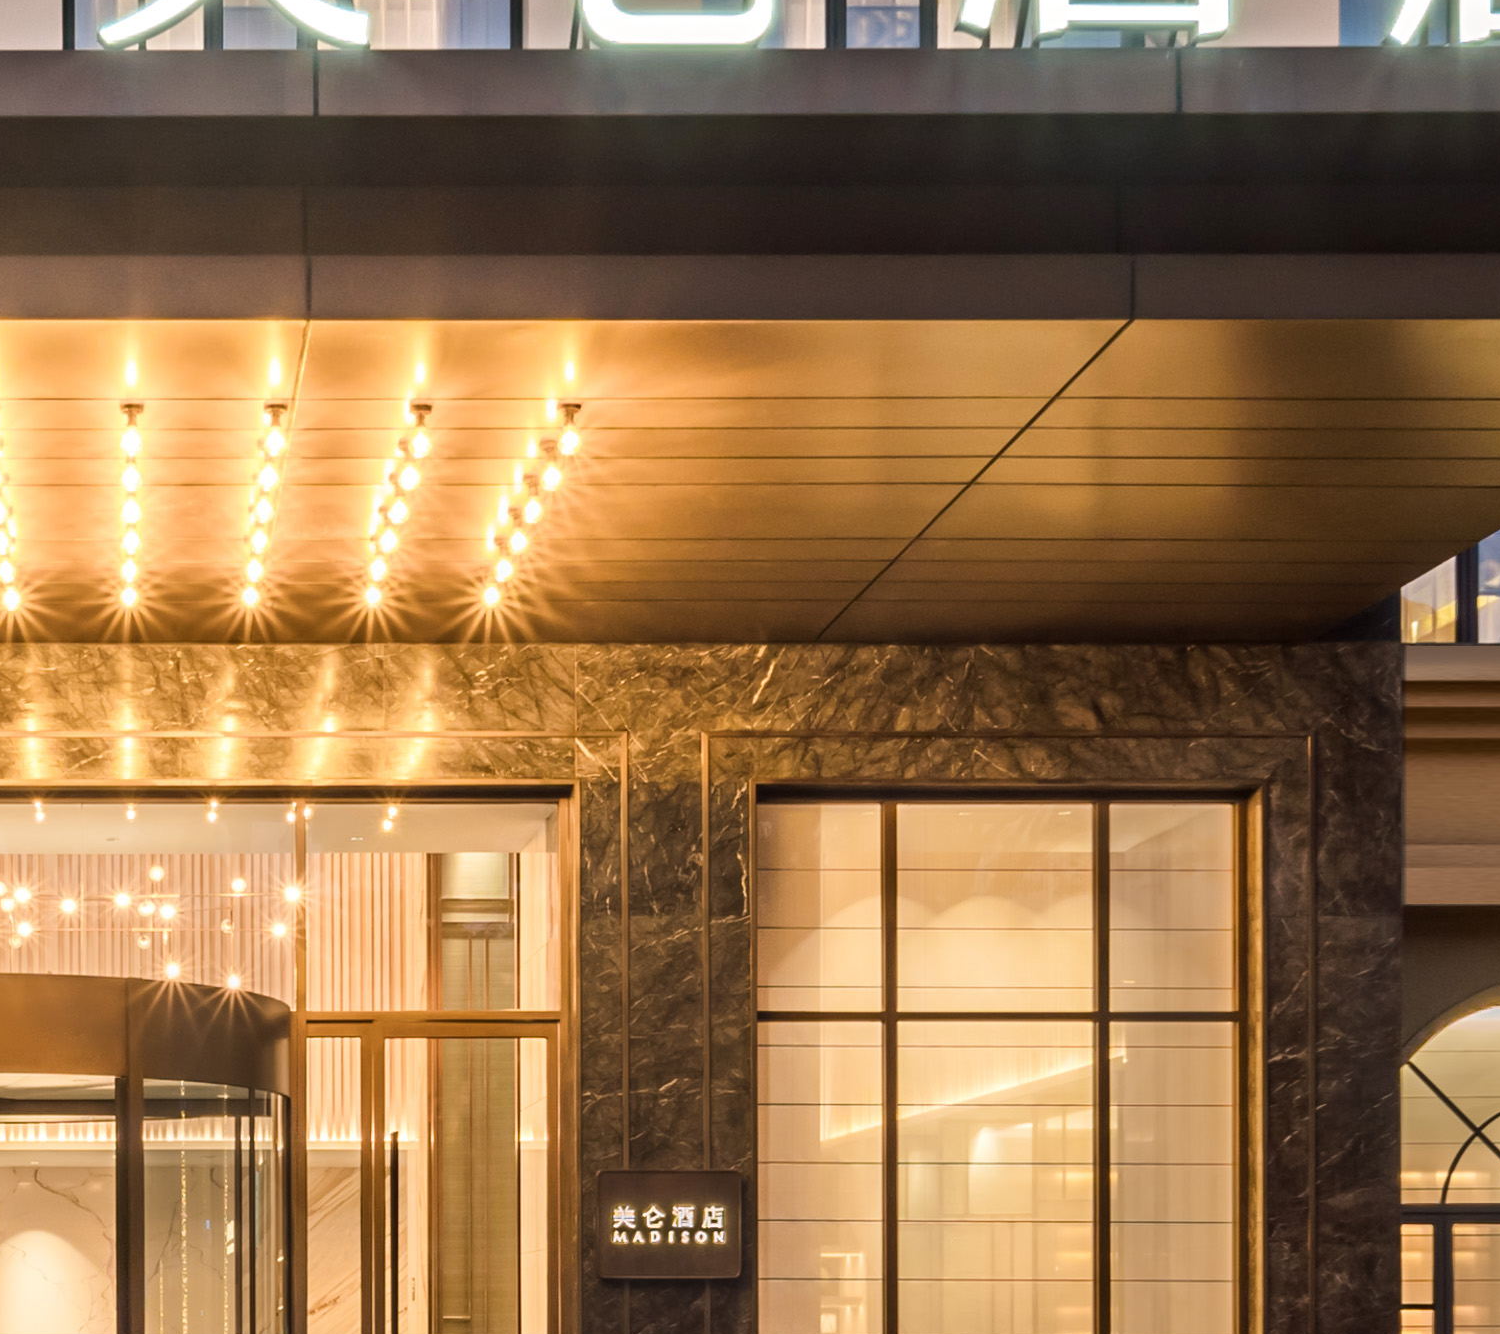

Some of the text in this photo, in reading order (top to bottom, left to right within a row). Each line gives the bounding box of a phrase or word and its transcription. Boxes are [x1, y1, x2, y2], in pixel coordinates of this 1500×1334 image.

[611, 1204, 725, 1229] 美仑酒店
[611, 1230, 727, 1245] MADISON
